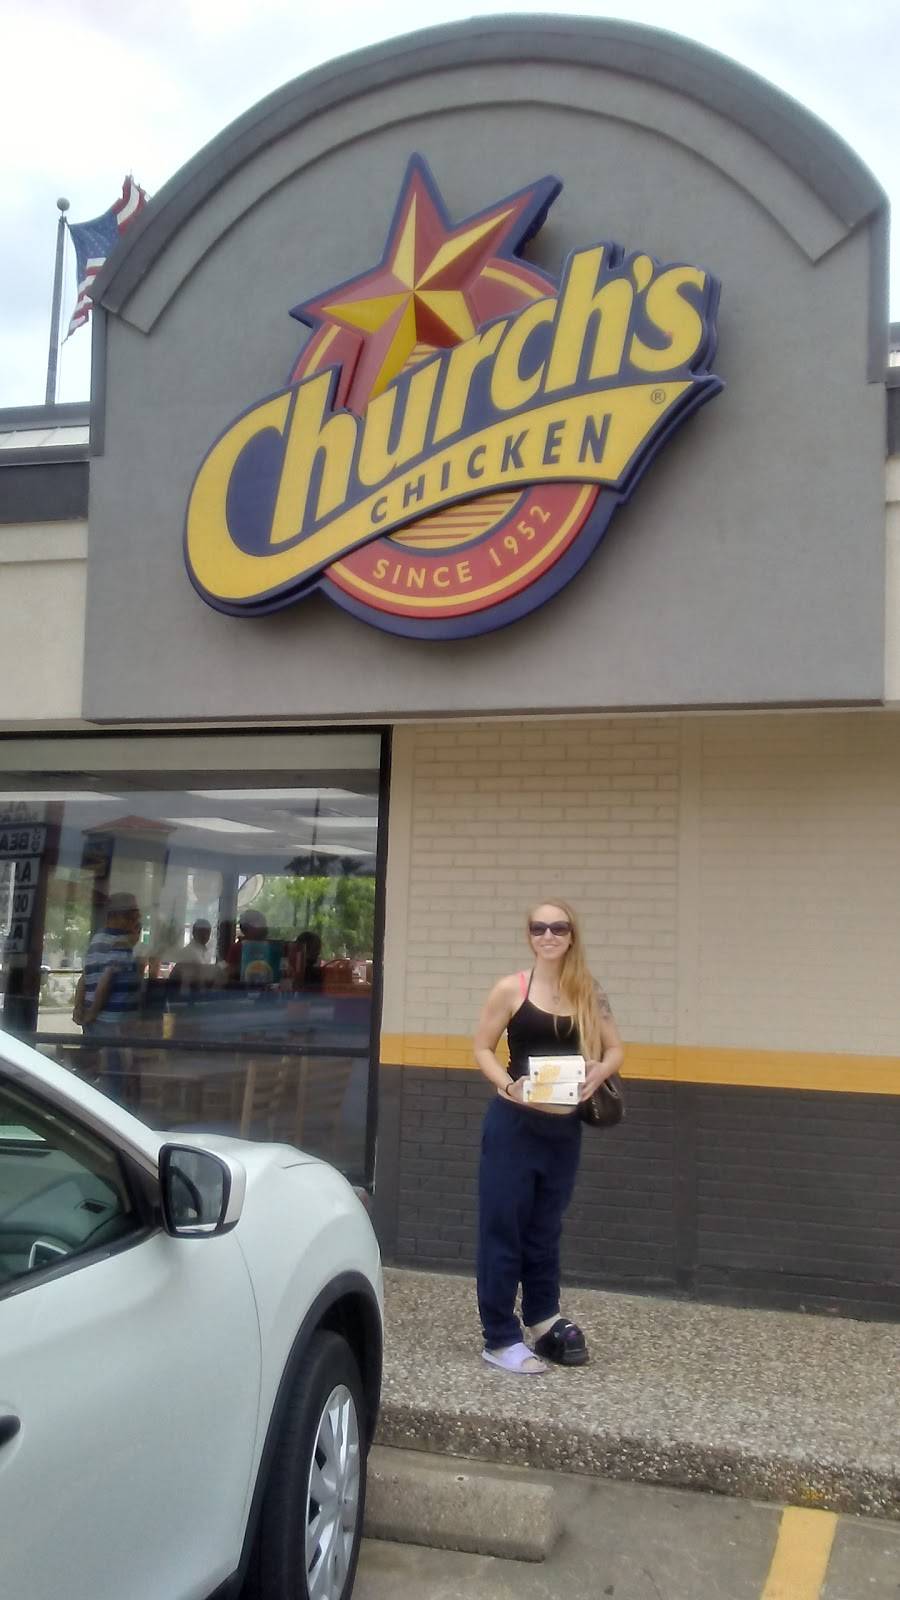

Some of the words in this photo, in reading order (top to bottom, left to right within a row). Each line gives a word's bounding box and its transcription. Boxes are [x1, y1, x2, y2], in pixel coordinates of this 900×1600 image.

[184, 245, 706, 599] Church's
[370, 413, 612, 524] CHICKEN
[372, 558, 473, 589] SINCE
[488, 504, 551, 568] 1952
